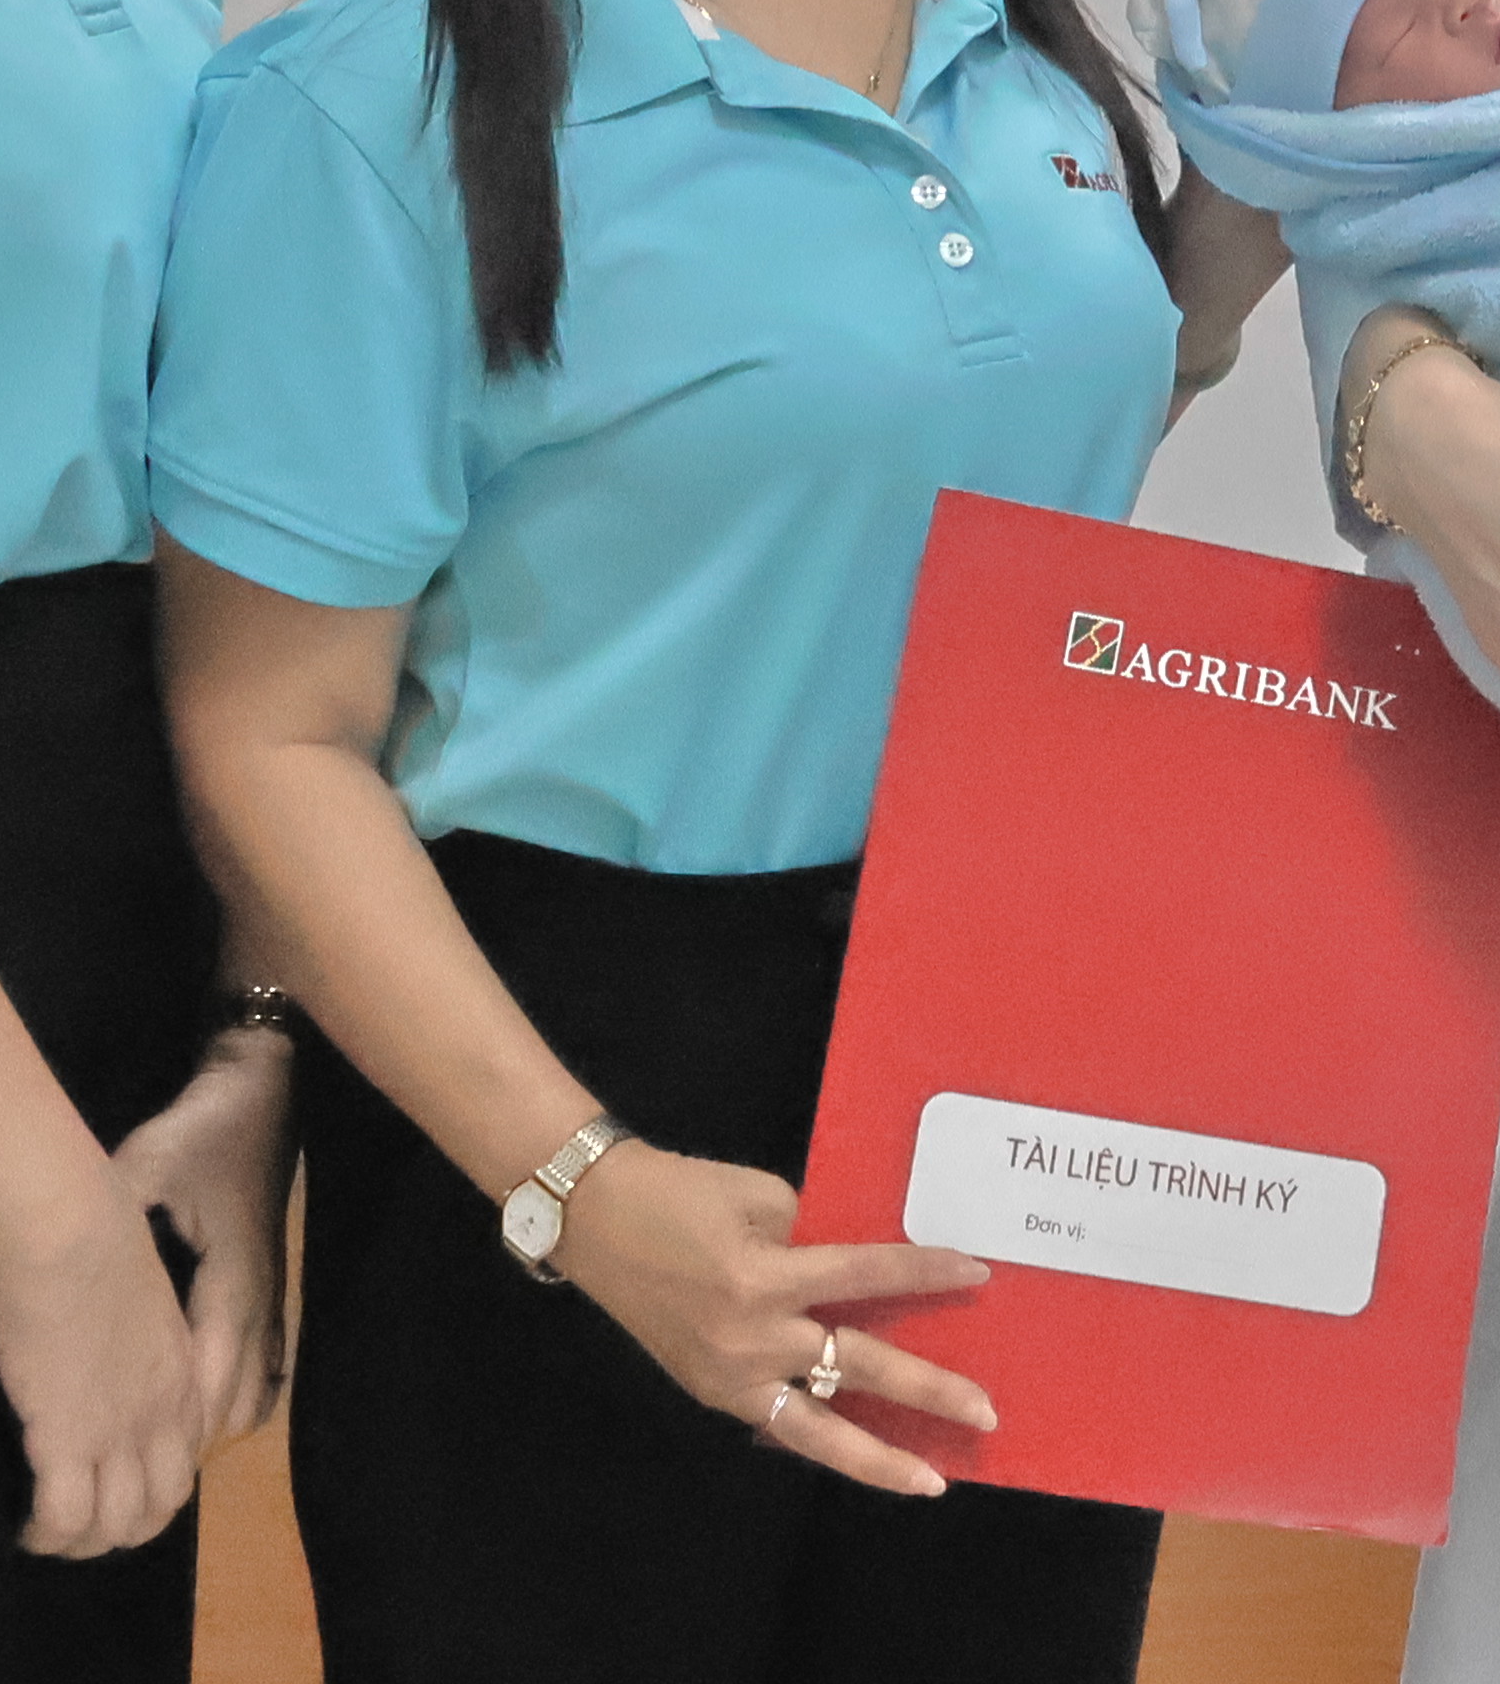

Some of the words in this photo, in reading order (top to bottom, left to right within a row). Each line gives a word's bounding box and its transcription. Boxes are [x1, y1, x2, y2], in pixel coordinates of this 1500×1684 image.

[1120, 643, 1398, 730] AGRIBANK
[1006, 1136, 1057, 1174] TÀI
[1067, 1147, 1138, 1190] LIỆU
[1148, 1161, 1247, 1206] TRÌNH
[1255, 1178, 1298, 1214] KÝ
[1024, 1213, 1062, 1236] Đơn
